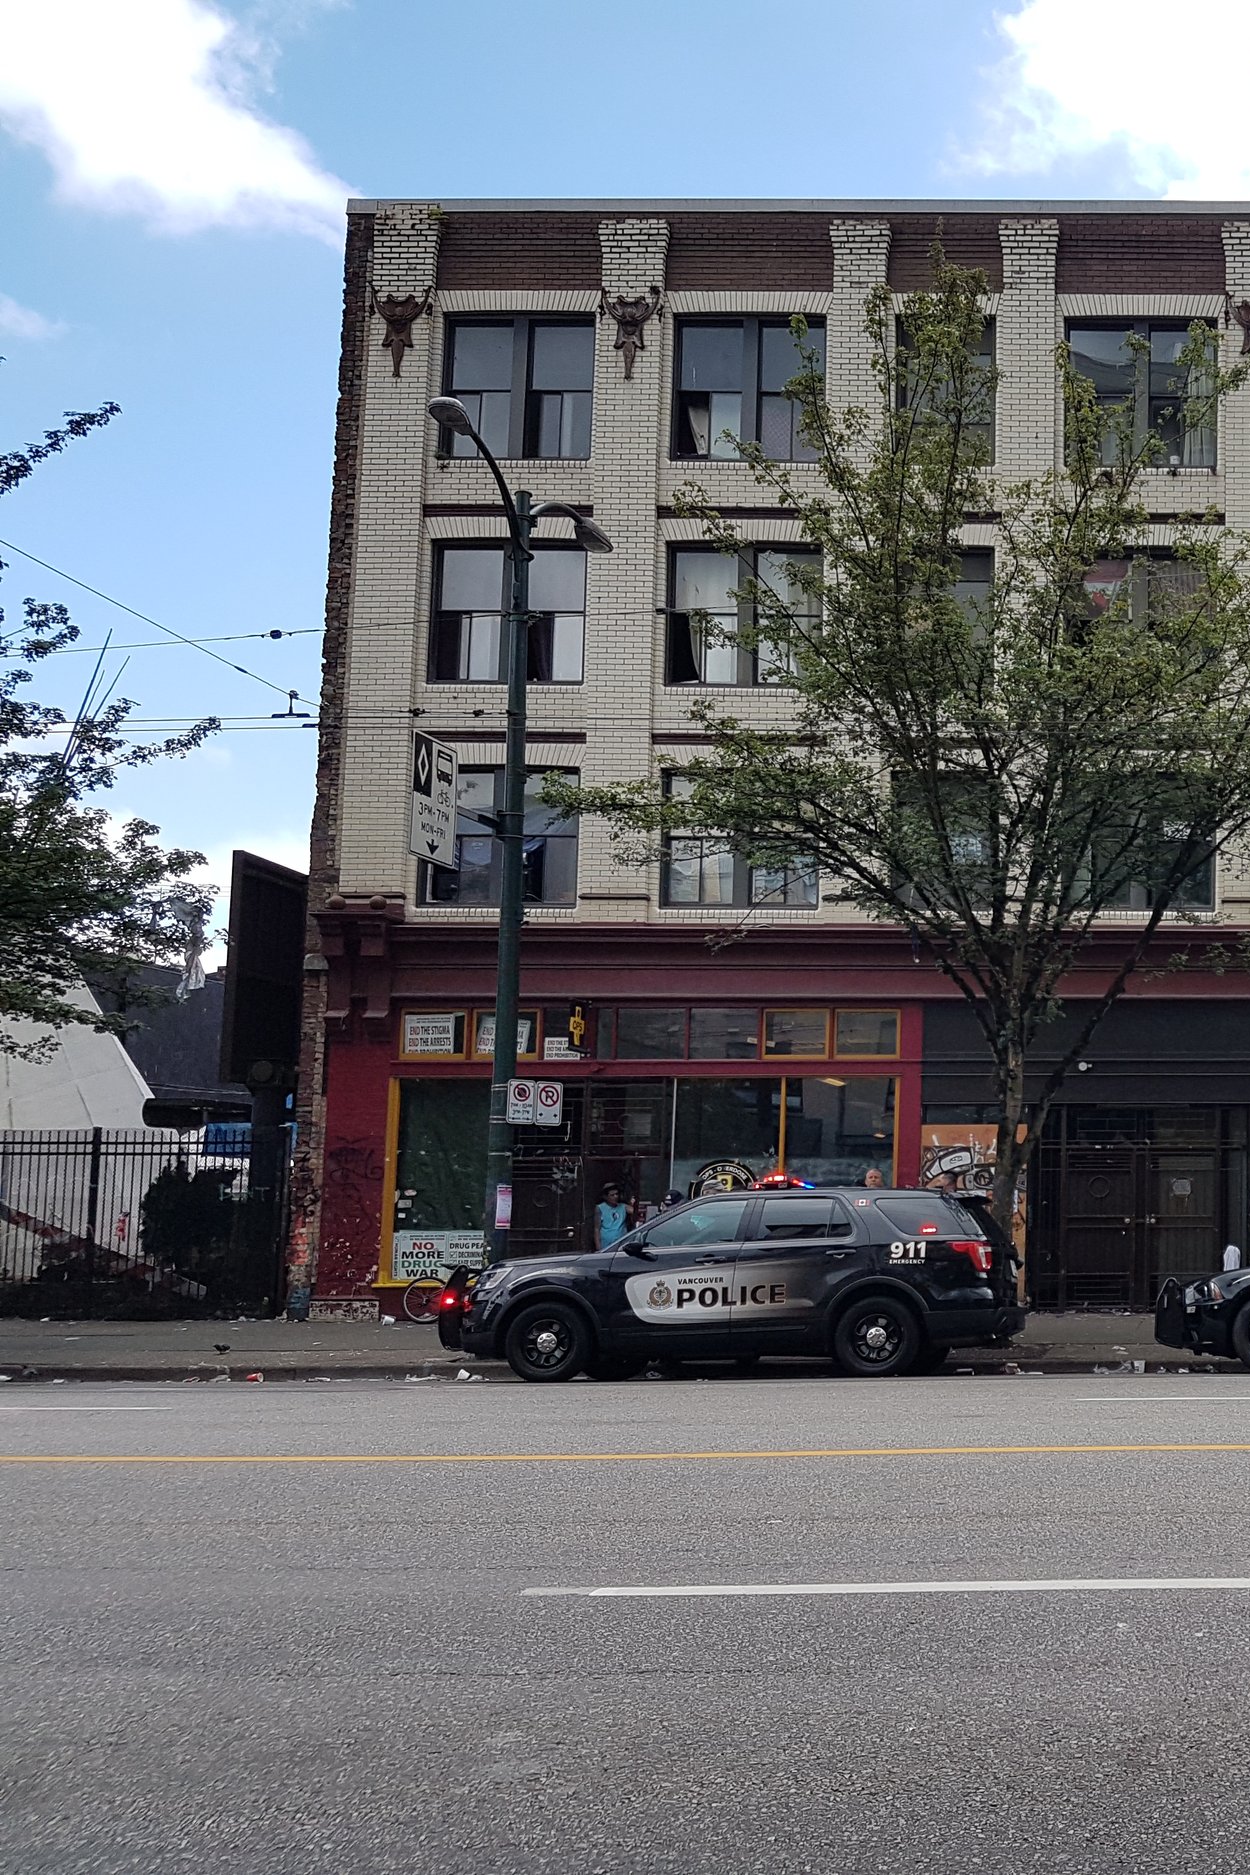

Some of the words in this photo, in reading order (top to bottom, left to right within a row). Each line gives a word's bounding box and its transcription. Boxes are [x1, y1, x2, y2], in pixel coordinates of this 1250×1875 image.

[409, 1026, 420, 1035] END
[421, 1026, 430, 1035] THE
[420, 1037, 429, 1046] THE
[412, 1242, 435, 1250] NO
[890, 1241, 926, 1258] 911
[401, 1251, 445, 1259] MORE
[405, 1269, 439, 1277] WAR
[677, 1277, 724, 1285] VANCOUVER
[676, 1283, 786, 1309] POLICE
